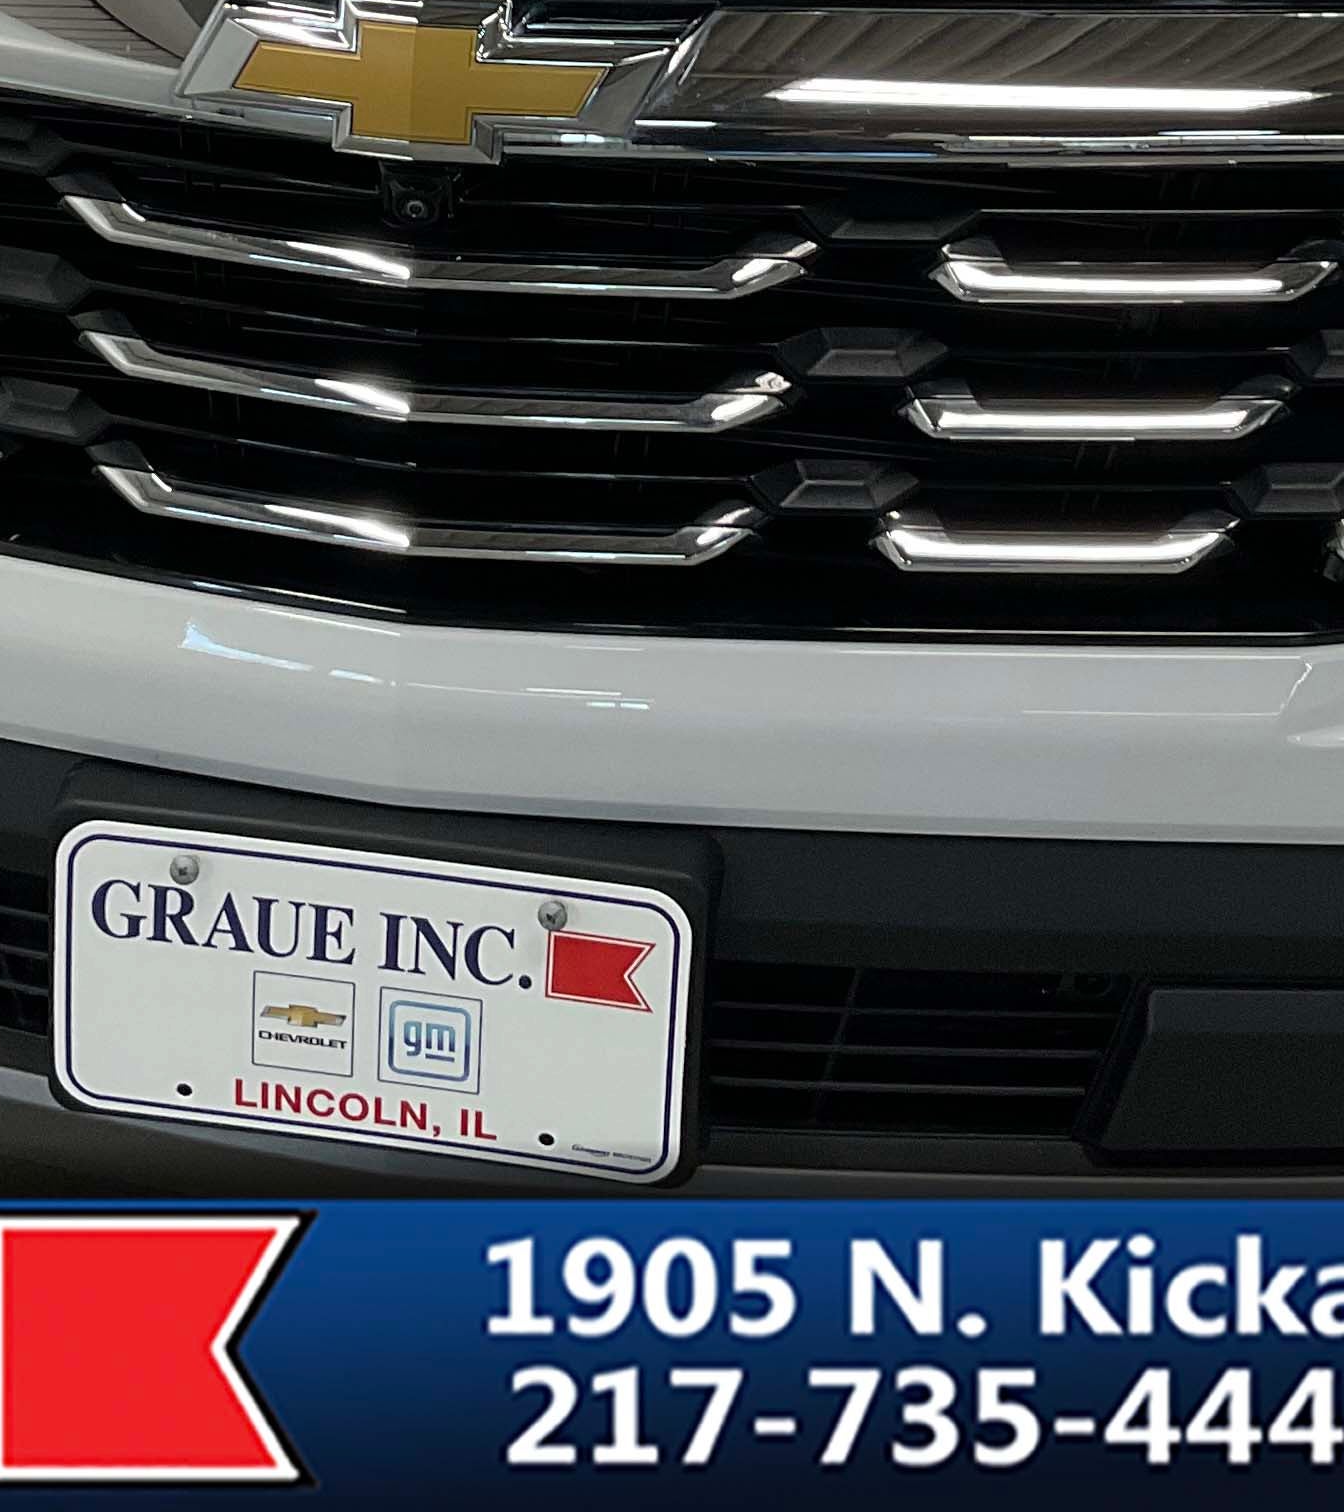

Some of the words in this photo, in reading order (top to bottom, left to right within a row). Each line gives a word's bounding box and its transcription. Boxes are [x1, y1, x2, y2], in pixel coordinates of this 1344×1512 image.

[90, 878, 356, 966] GRAUE
[377, 911, 533, 991] INC.
[257, 1029, 348, 1051] CHEVROLET
[403, 1023, 457, 1056] gm
[233, 1078, 442, 1139] LINCOLN,
[460, 1108, 498, 1141] IL
